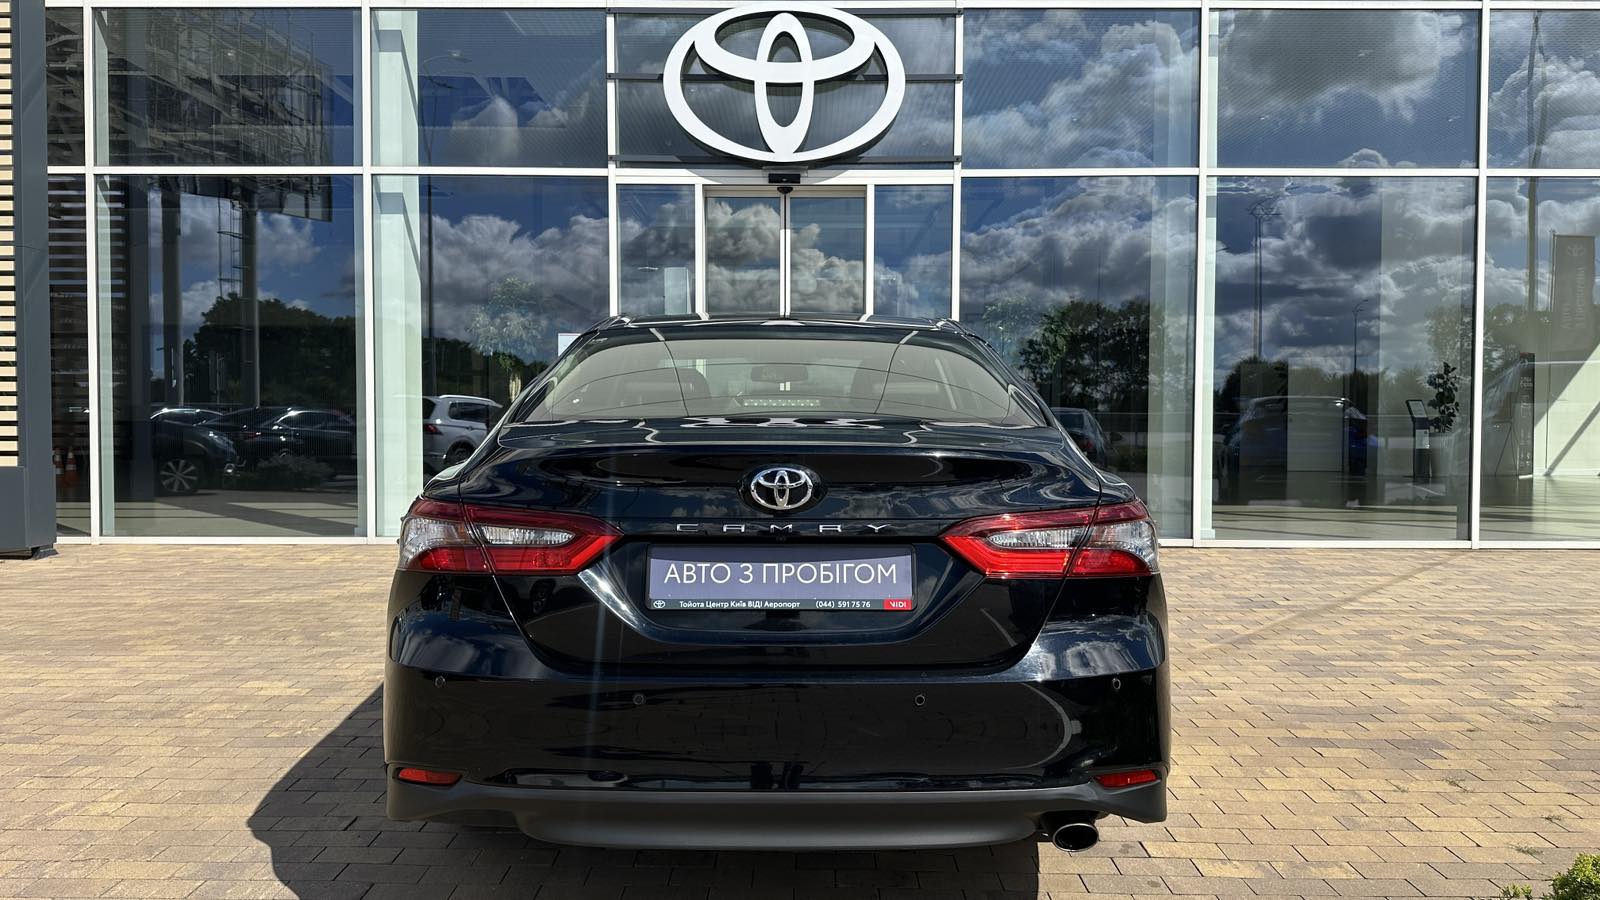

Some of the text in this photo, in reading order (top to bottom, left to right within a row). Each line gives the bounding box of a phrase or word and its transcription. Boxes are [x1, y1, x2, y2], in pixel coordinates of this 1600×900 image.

[676, 523, 890, 533] CAMRY
[664, 563, 731, 584] АВТО
[763, 563, 897, 584] ПРОБІГОМ
[680, 600, 704, 609] Тойота
[706, 601, 728, 609] Центр
[764, 601, 801, 609] Аеропорт
[815, 600, 835, 609] (044)
